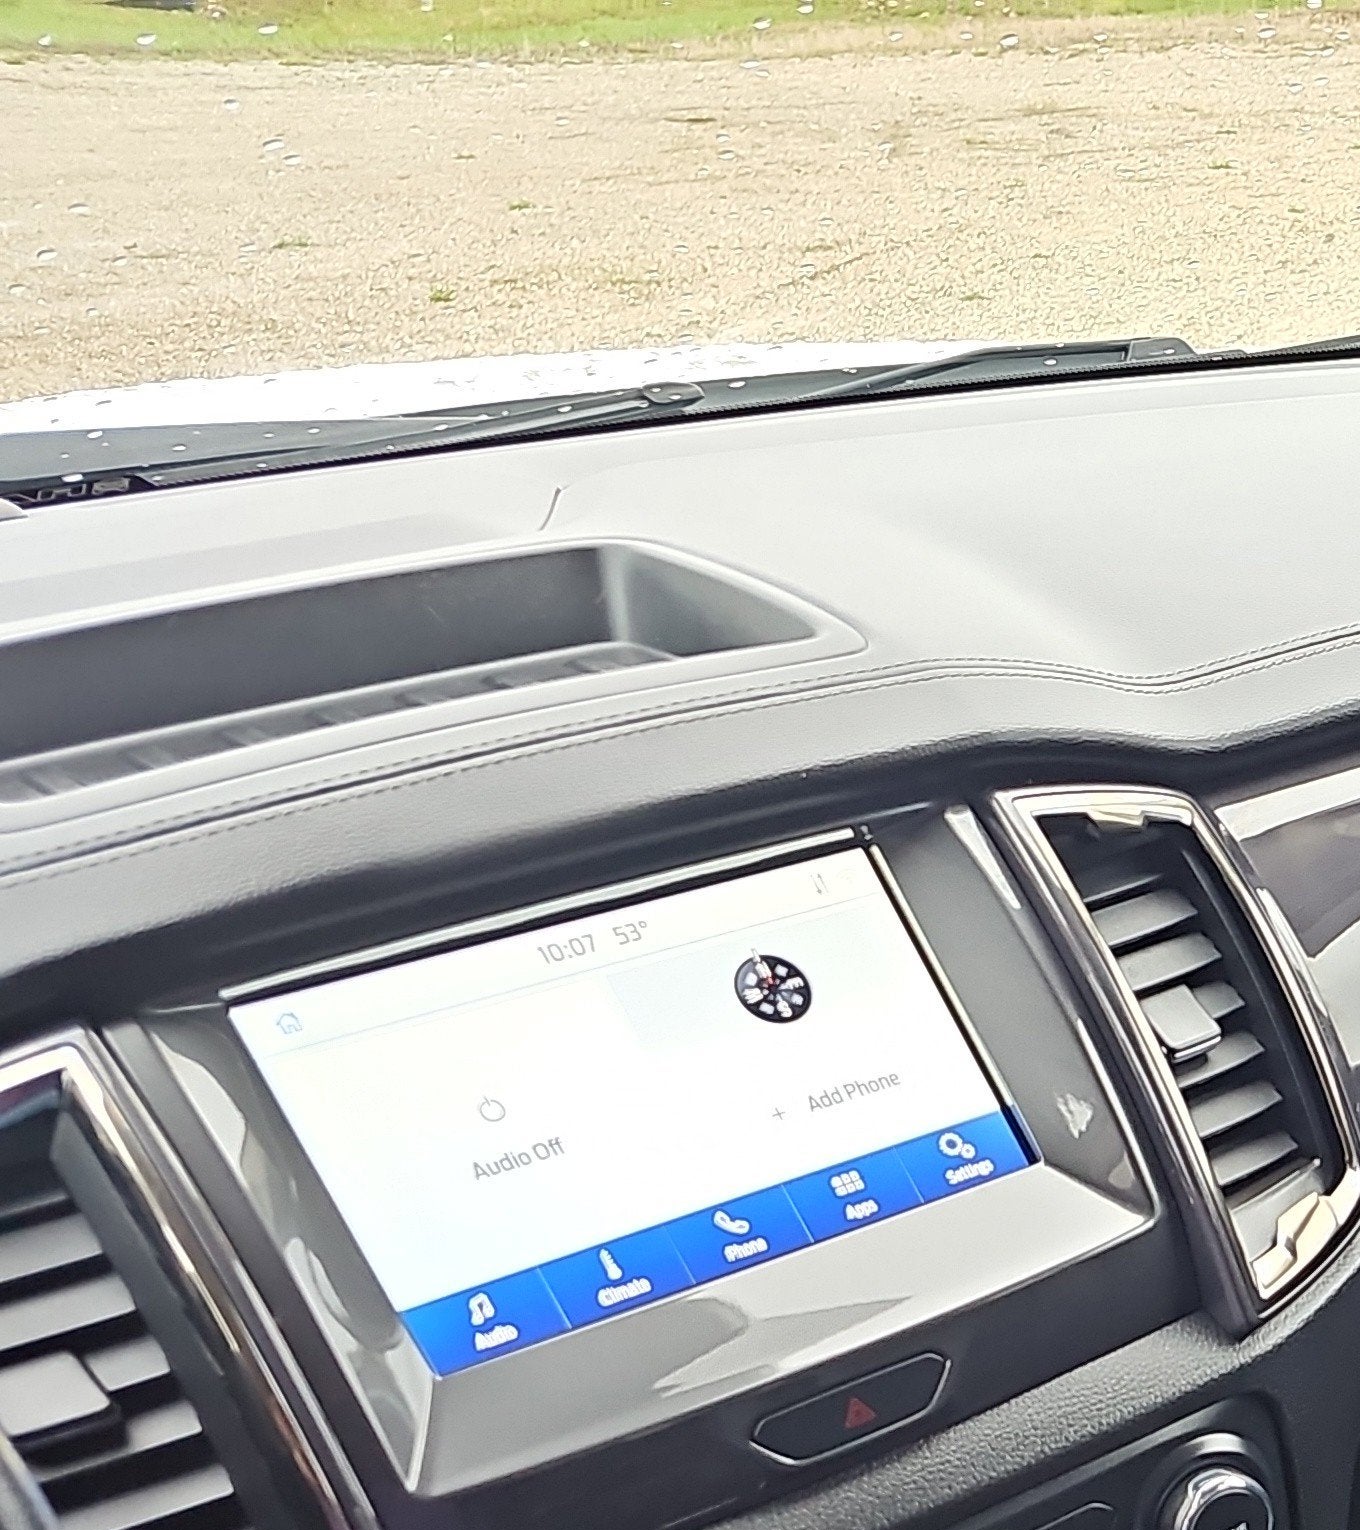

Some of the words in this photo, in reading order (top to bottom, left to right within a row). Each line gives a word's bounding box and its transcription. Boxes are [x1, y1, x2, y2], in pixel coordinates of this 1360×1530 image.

[537, 934, 596, 965] 10:07
[612, 920, 648, 946] 53°
[807, 1085, 844, 1113] Add
[843, 1071, 901, 1101] Phone
[472, 1149, 532, 1181] Audio
[531, 1136, 566, 1161] Off
